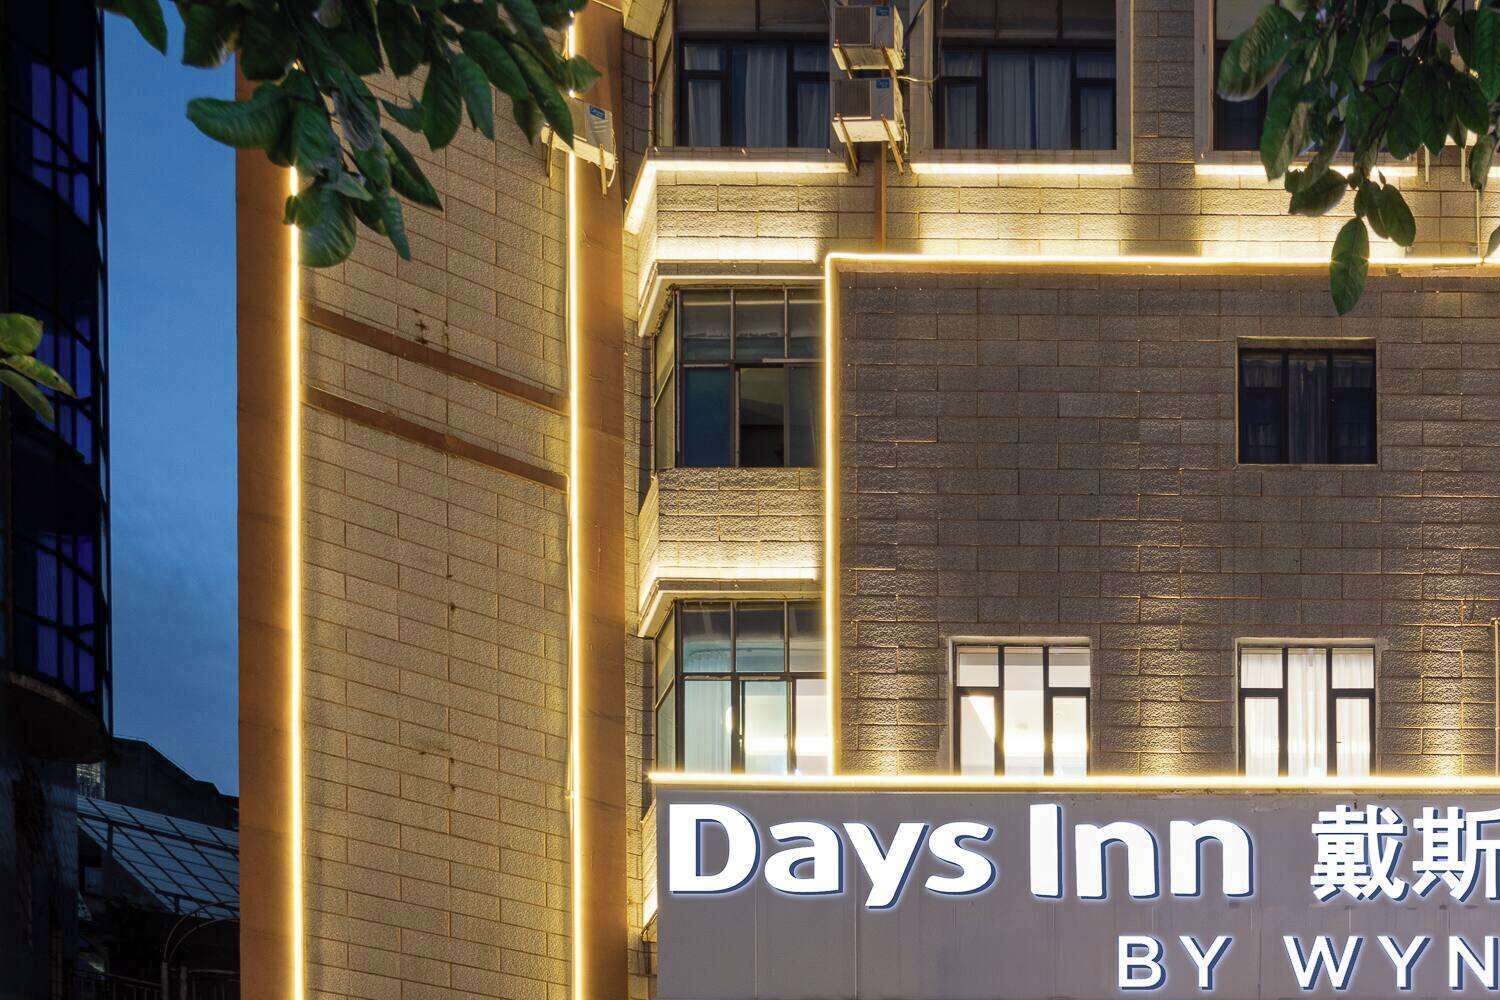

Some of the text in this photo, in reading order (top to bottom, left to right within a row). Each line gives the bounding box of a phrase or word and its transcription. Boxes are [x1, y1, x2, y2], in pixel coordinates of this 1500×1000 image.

[668, 803, 1253, 908] Days Inn
[1117, 935, 1231, 990] BY
